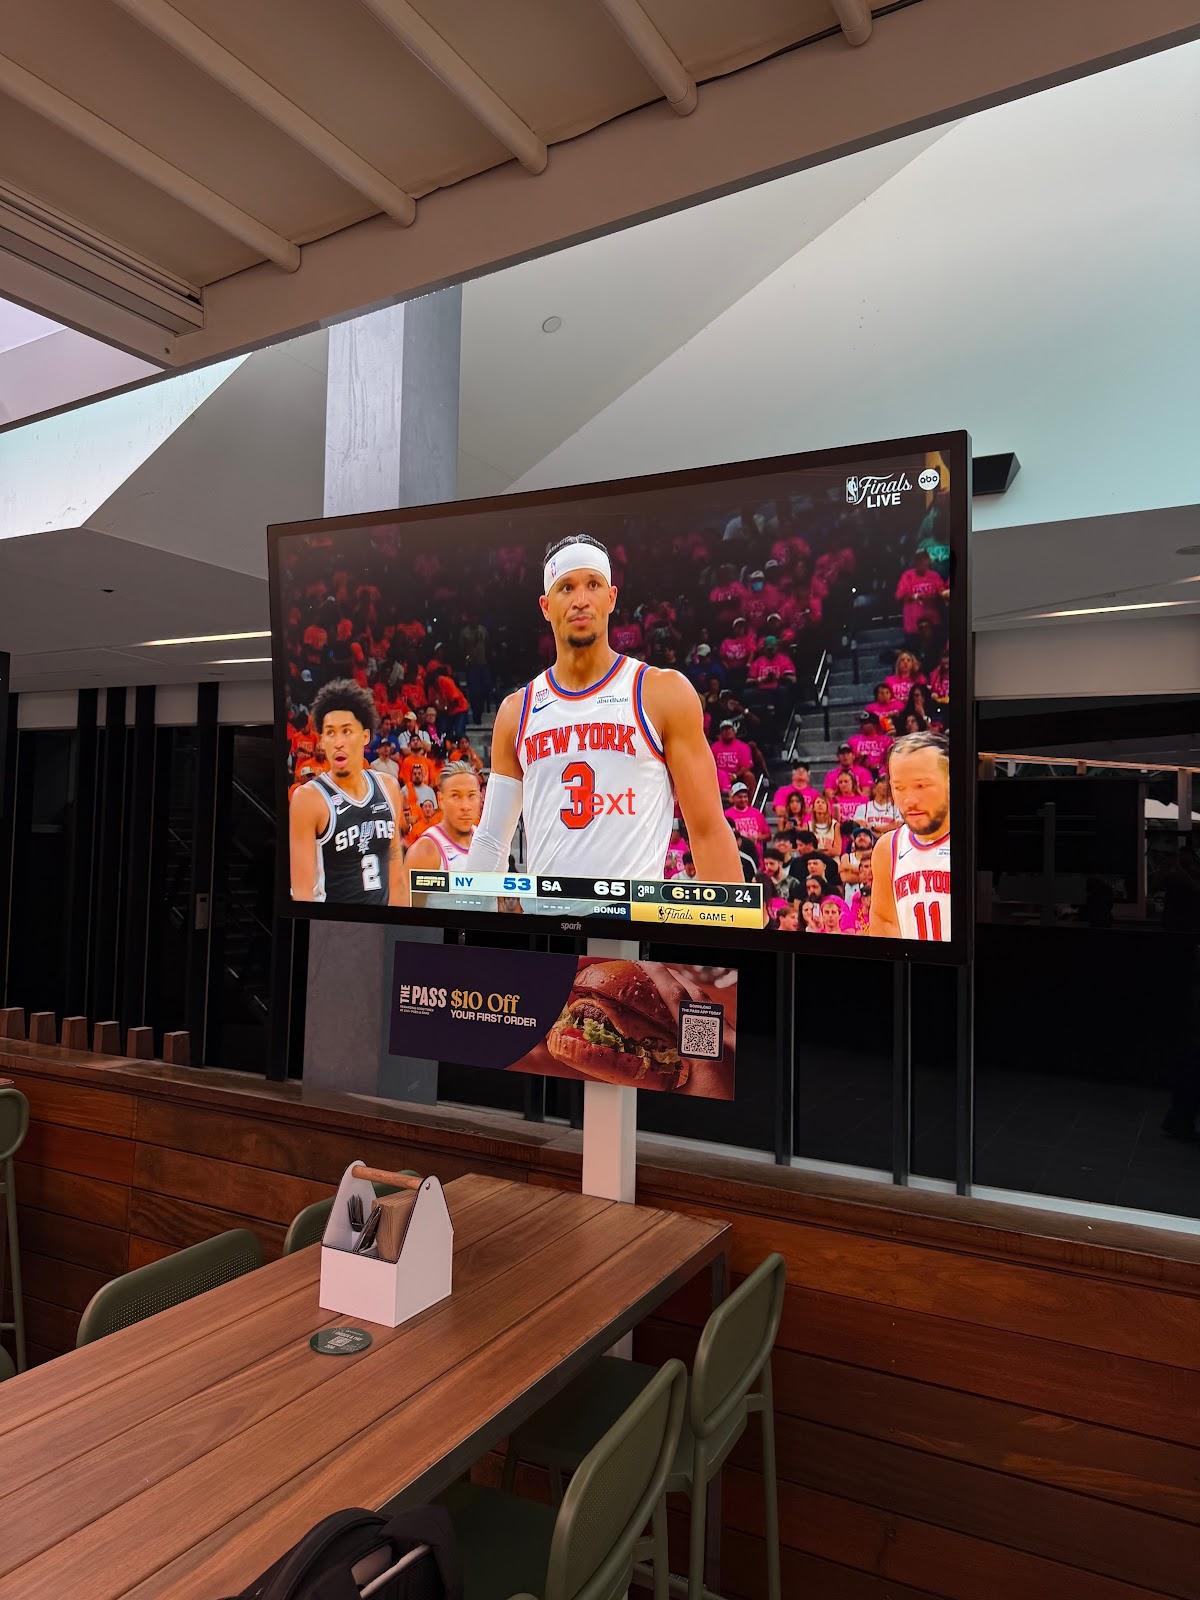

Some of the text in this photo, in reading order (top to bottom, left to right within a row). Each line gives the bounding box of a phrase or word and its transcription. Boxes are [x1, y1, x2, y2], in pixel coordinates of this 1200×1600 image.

[853, 472, 913, 505] Finals
[866, 492, 901, 508] LIVE
[524, 722, 637, 765] NEW YORK
[560, 761, 595, 830] 3
[360, 853, 383, 892] 2
[415, 875, 752, 903] ESPN NY 53 SA 65 3RD 6:10 24
[593, 906, 627, 915] BONUS
[664, 907, 734, 923] Finals GAME 1
[913, 901, 943, 940] 11
[400, 984, 447, 1008] THE PASS
[450, 988, 483, 1010] $10
[487, 993, 521, 1014] Off
[450, 1009, 537, 1027] YOUR FIRST ORDER
